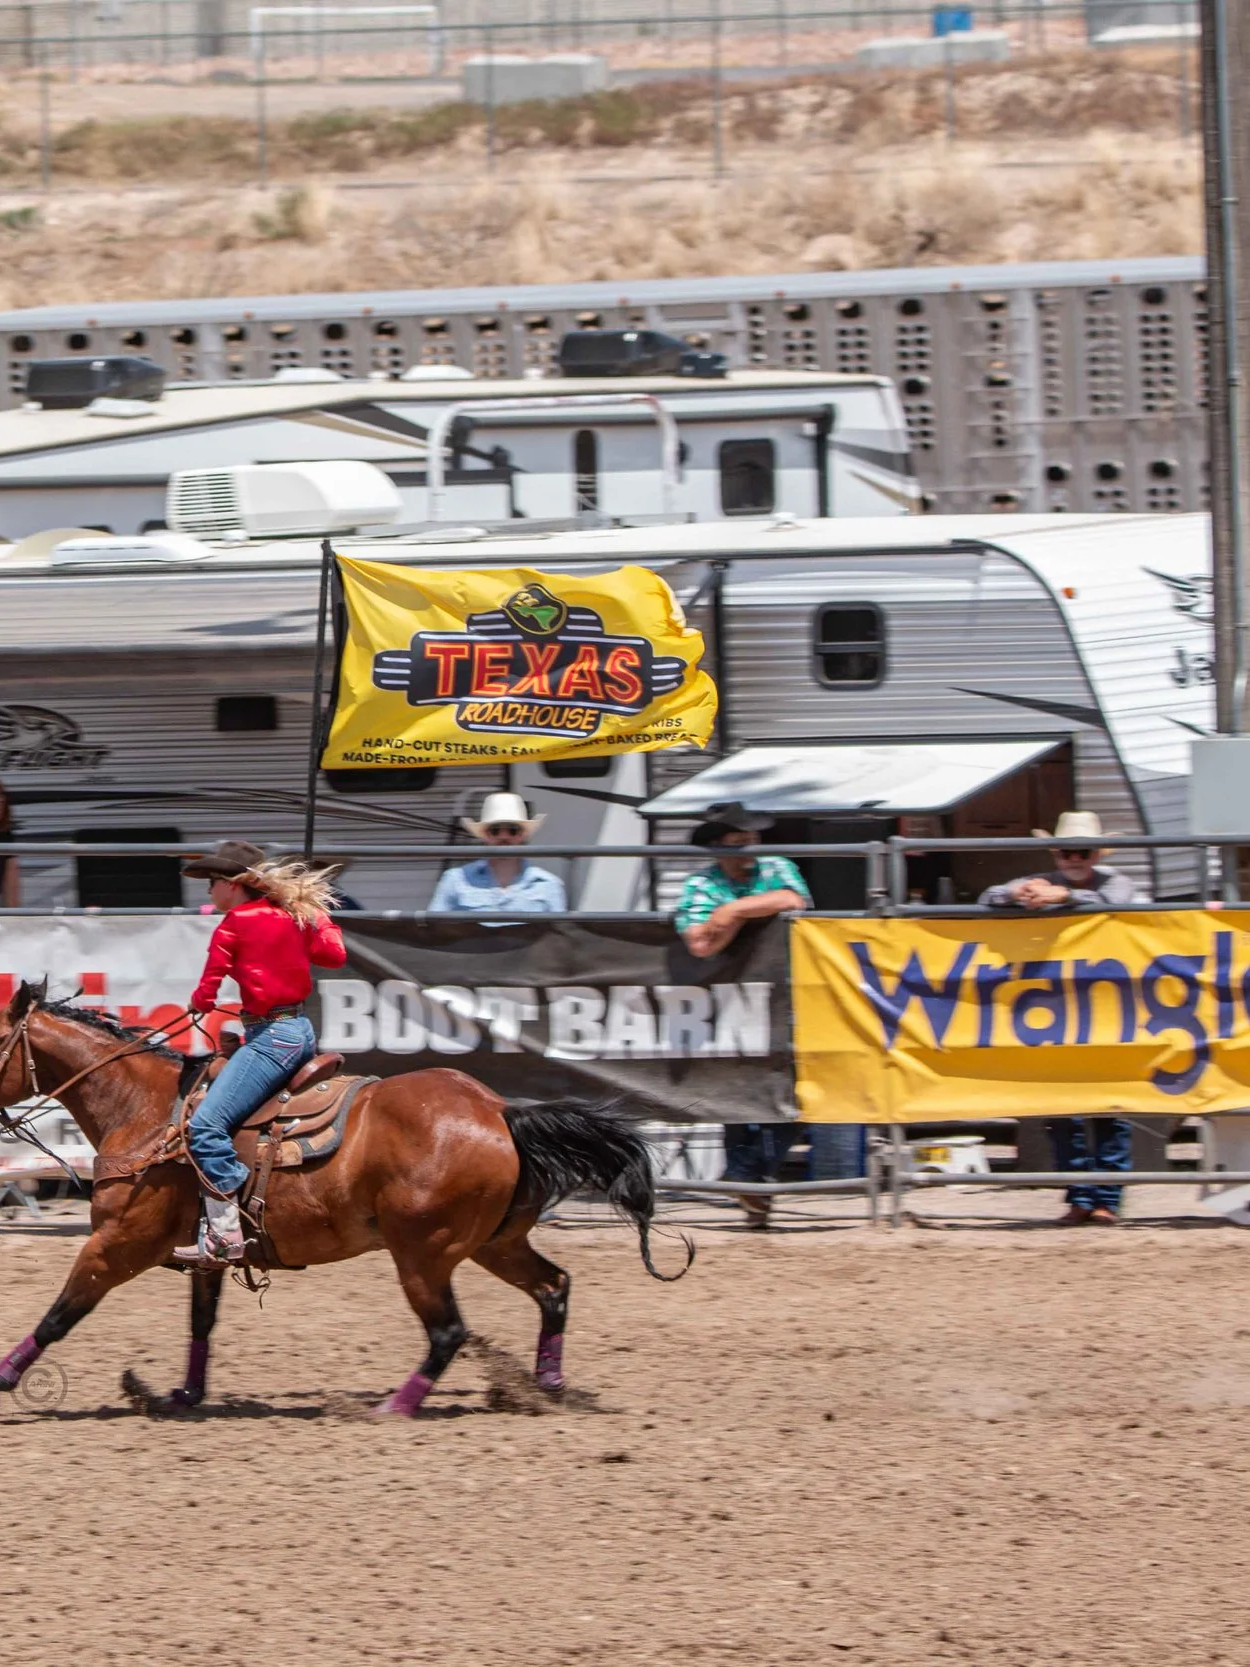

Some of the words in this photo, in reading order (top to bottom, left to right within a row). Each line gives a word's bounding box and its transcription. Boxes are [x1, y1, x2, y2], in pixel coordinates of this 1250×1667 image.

[424, 641, 642, 704] TEXAS
[362, 738, 441, 753] HAND-CUT
[444, 743, 498, 756] STEAKS
[457, 701, 602, 731] ROADHOUSE
[317, 978, 539, 1054] BOOT
[544, 981, 774, 1061] BARN
[847, 930, 1250, 1095] Wrangl
